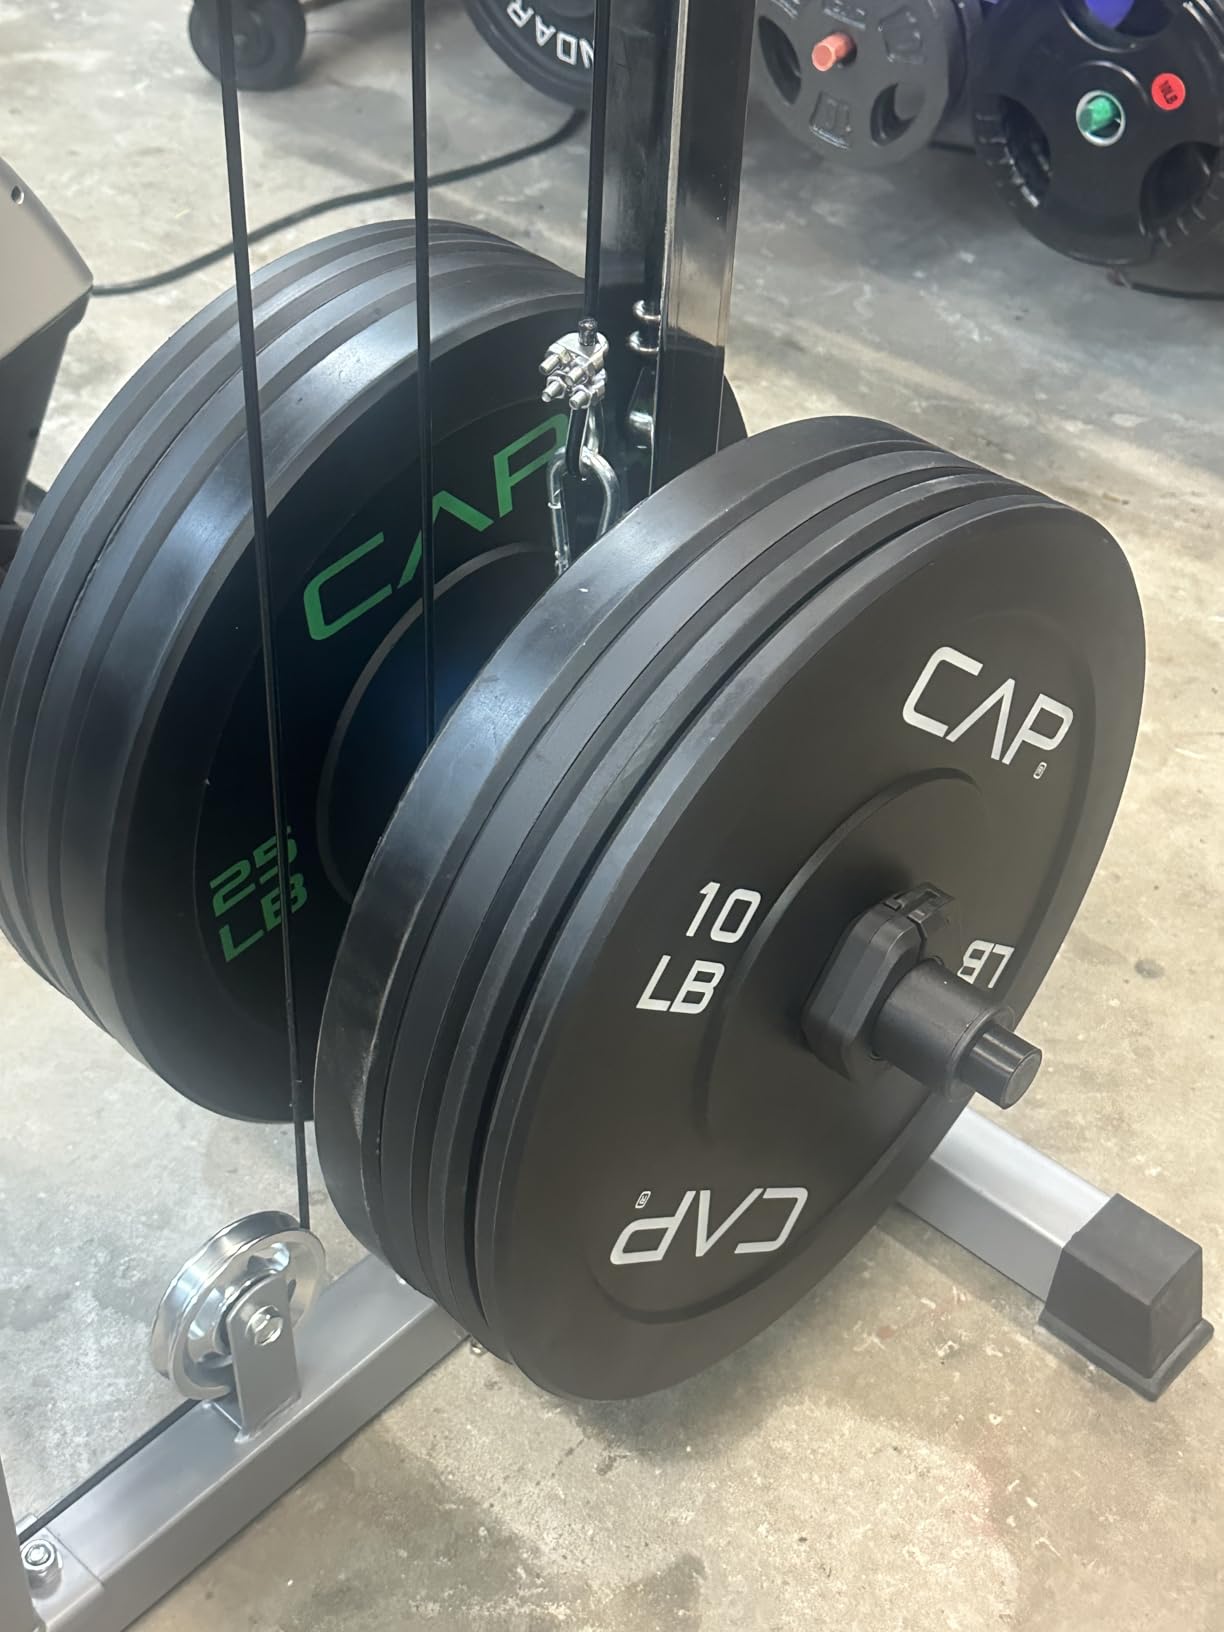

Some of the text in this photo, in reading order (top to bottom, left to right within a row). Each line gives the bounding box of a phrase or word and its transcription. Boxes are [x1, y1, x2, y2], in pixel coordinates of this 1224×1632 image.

[303, 413, 569, 640] CAP
[903, 646, 1073, 765] CAP
[209, 825, 298, 917] 25
[686, 881, 761, 943] 10
[219, 873, 308, 962] LB
[636, 955, 725, 1014] LB
[957, 940, 1015, 988] LB
[610, 1187, 808, 1265] CAP
